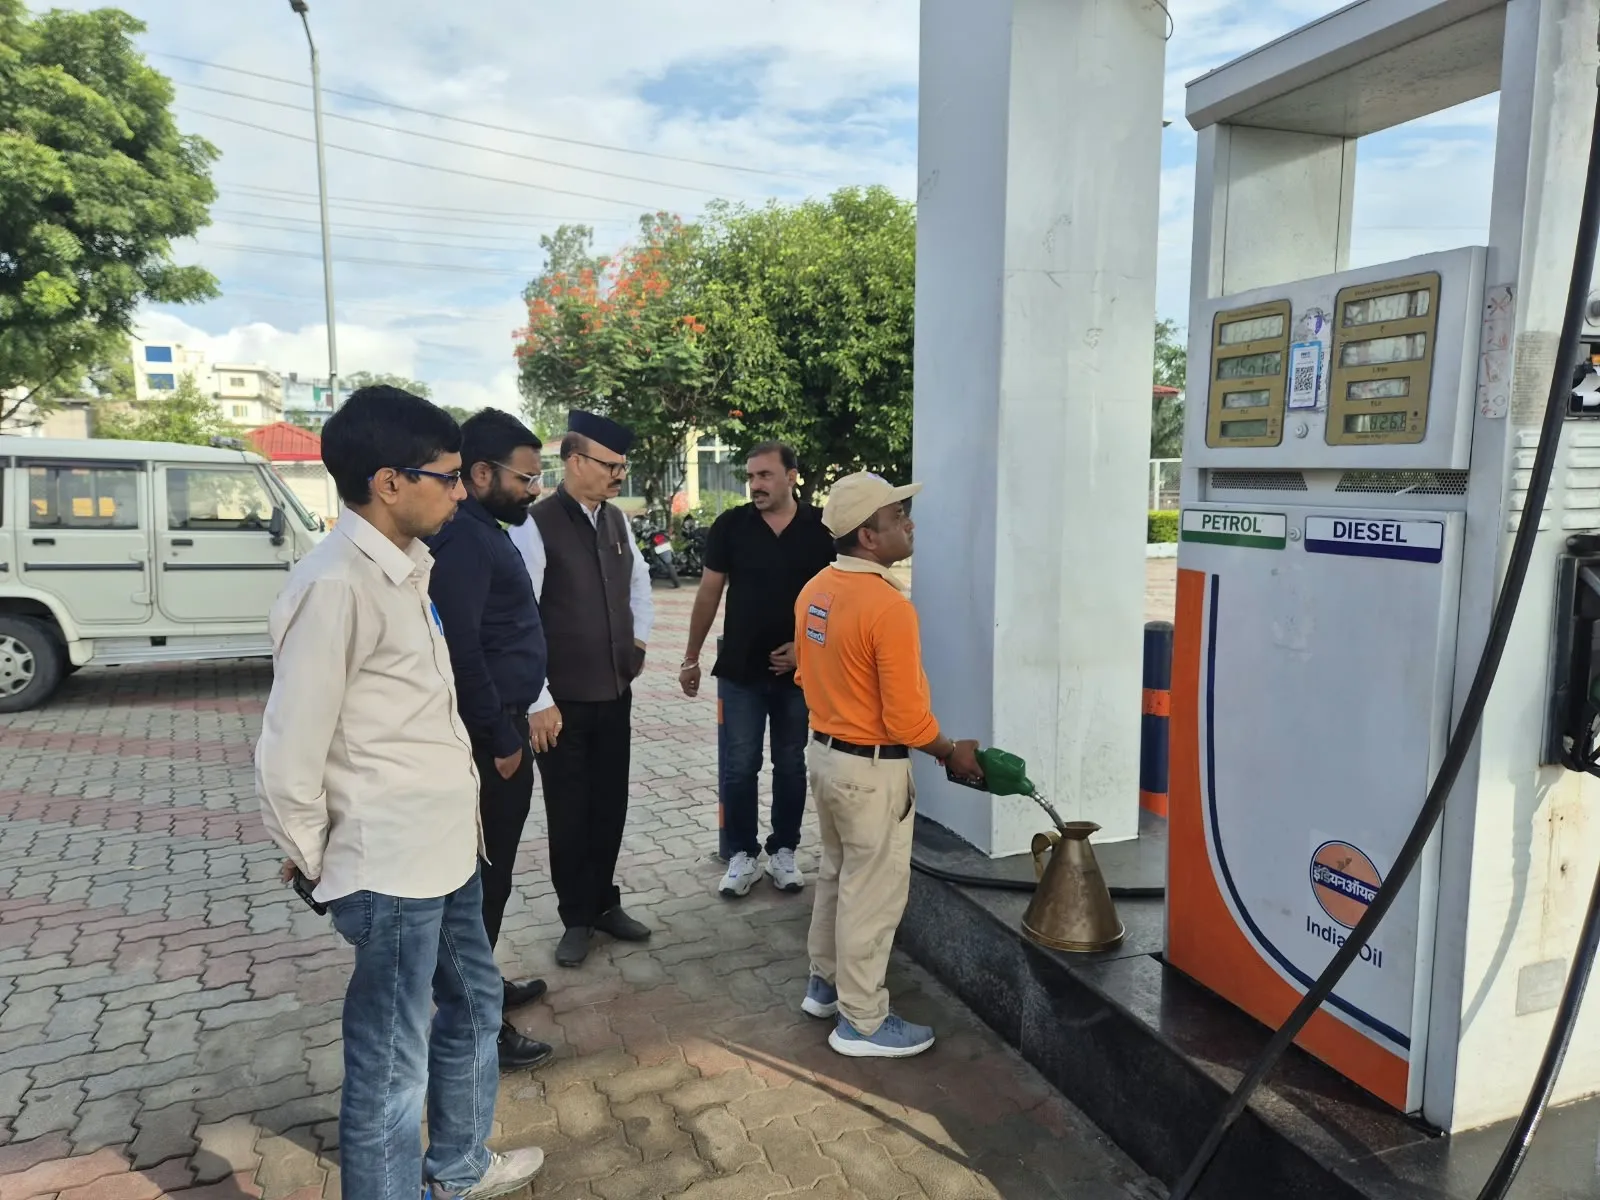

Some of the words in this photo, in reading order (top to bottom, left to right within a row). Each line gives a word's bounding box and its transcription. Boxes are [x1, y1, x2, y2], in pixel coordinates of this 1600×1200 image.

[1201, 514, 1262, 533] PETROL
[1333, 521, 1407, 543] DIESEL
[1306, 915, 1382, 968] IndiaOil
